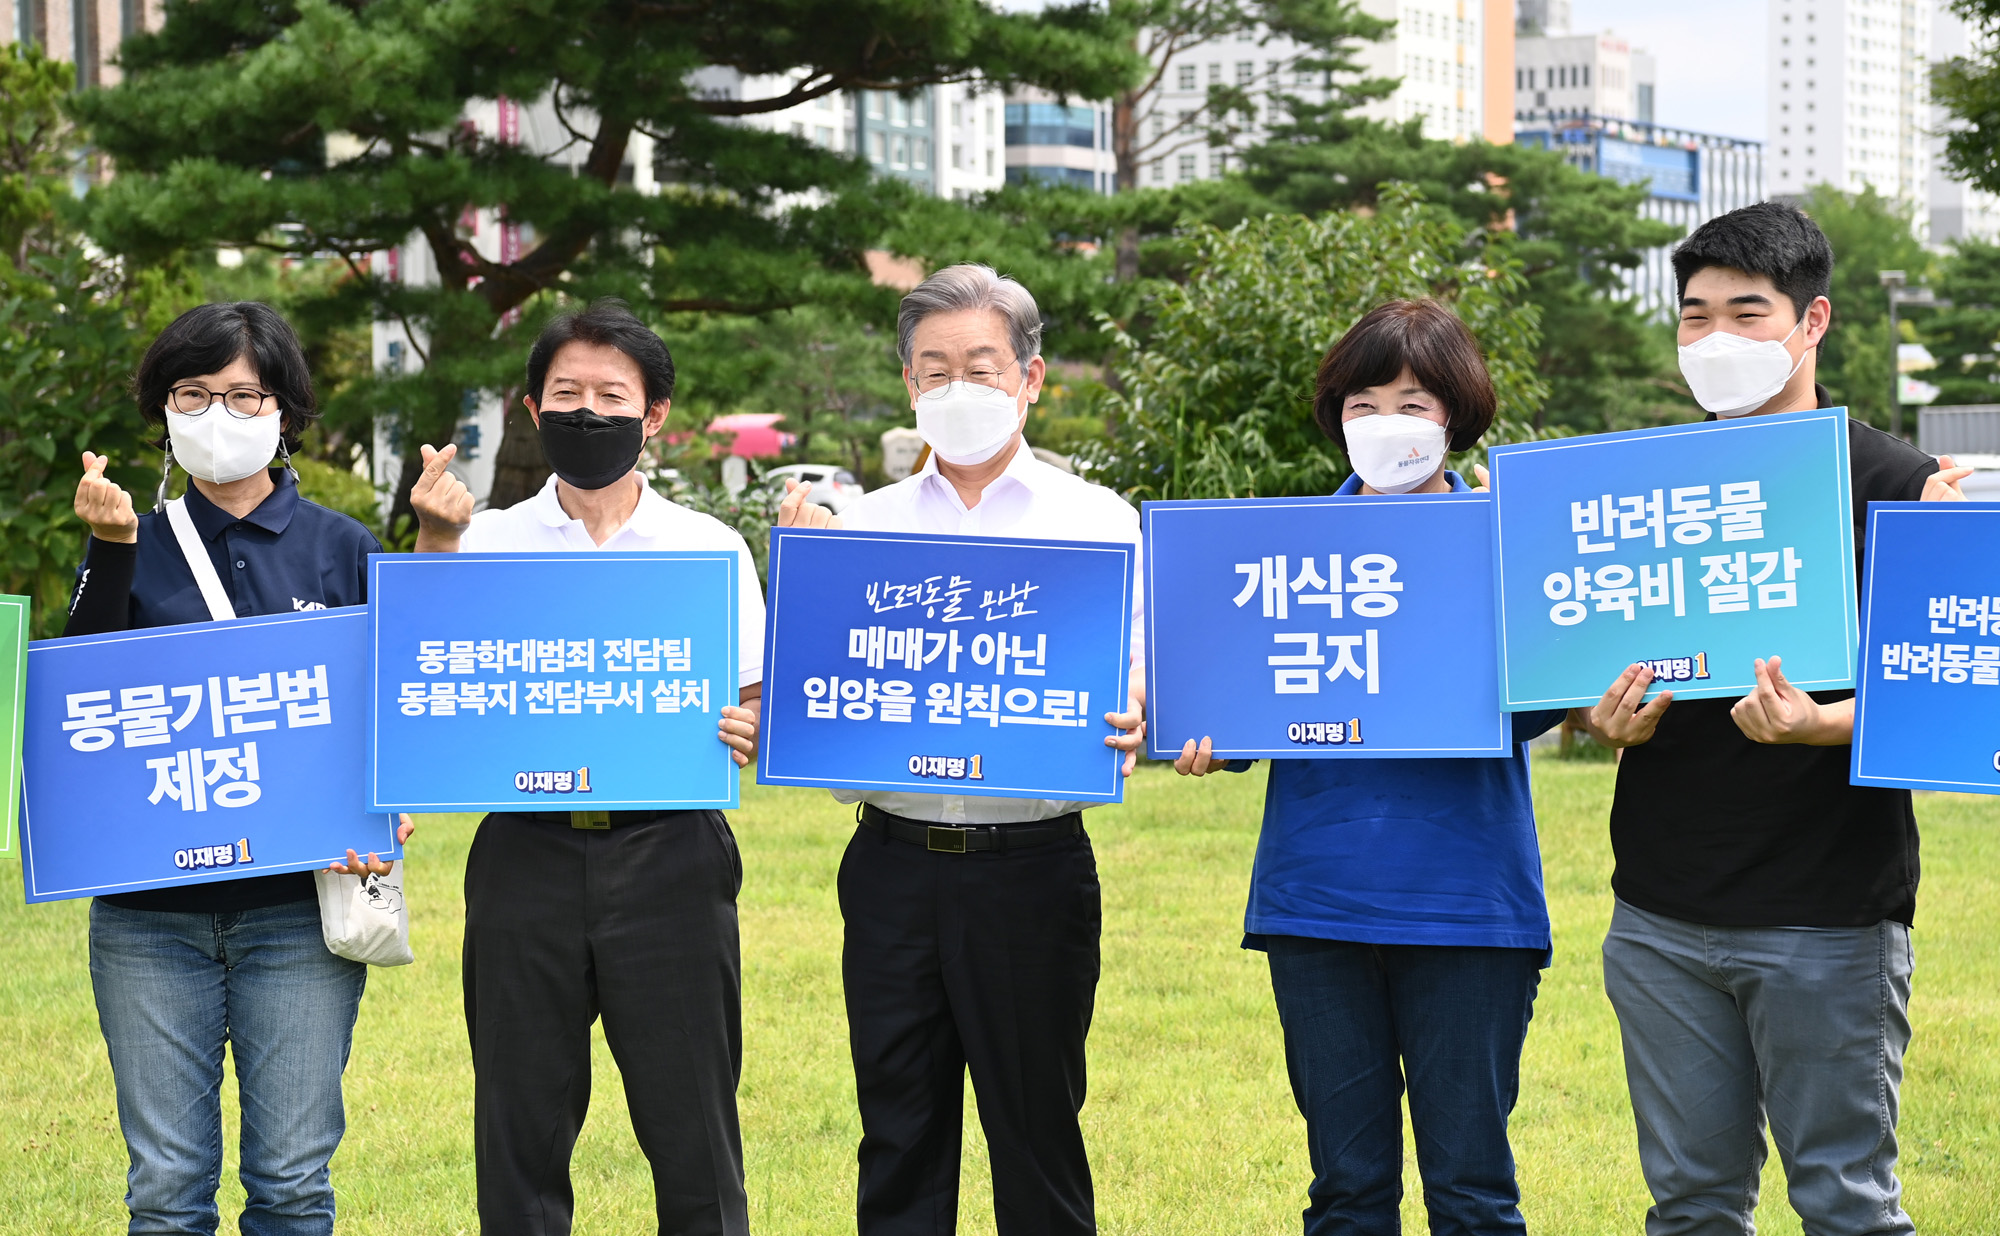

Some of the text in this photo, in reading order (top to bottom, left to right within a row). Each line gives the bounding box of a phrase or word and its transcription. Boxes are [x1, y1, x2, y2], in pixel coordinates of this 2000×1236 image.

[1570, 480, 1768, 555] 반려동물
[865, 575, 1040, 623] 반려동물 만남
[1232, 553, 1404, 620] 개식용
[1542, 546, 1803, 627] 양육비 절감
[416, 637, 691, 675] 동물학대범죄 전담팀
[848, 626, 1047, 677] 매매가 아닌
[1267, 629, 1380, 694] 금지
[61, 664, 332, 753] 동물기본법
[397, 678, 710, 717] 동물복지 전담부서 설치
[803, 676, 1090, 728] 입양을 원칙으로!
[1287, 722, 1345, 743] 이재명
[146, 741, 262, 813] 제정
[514, 770, 574, 793] 이재명
[908, 756, 966, 779] 이재명
[174, 844, 235, 870] 이재명
